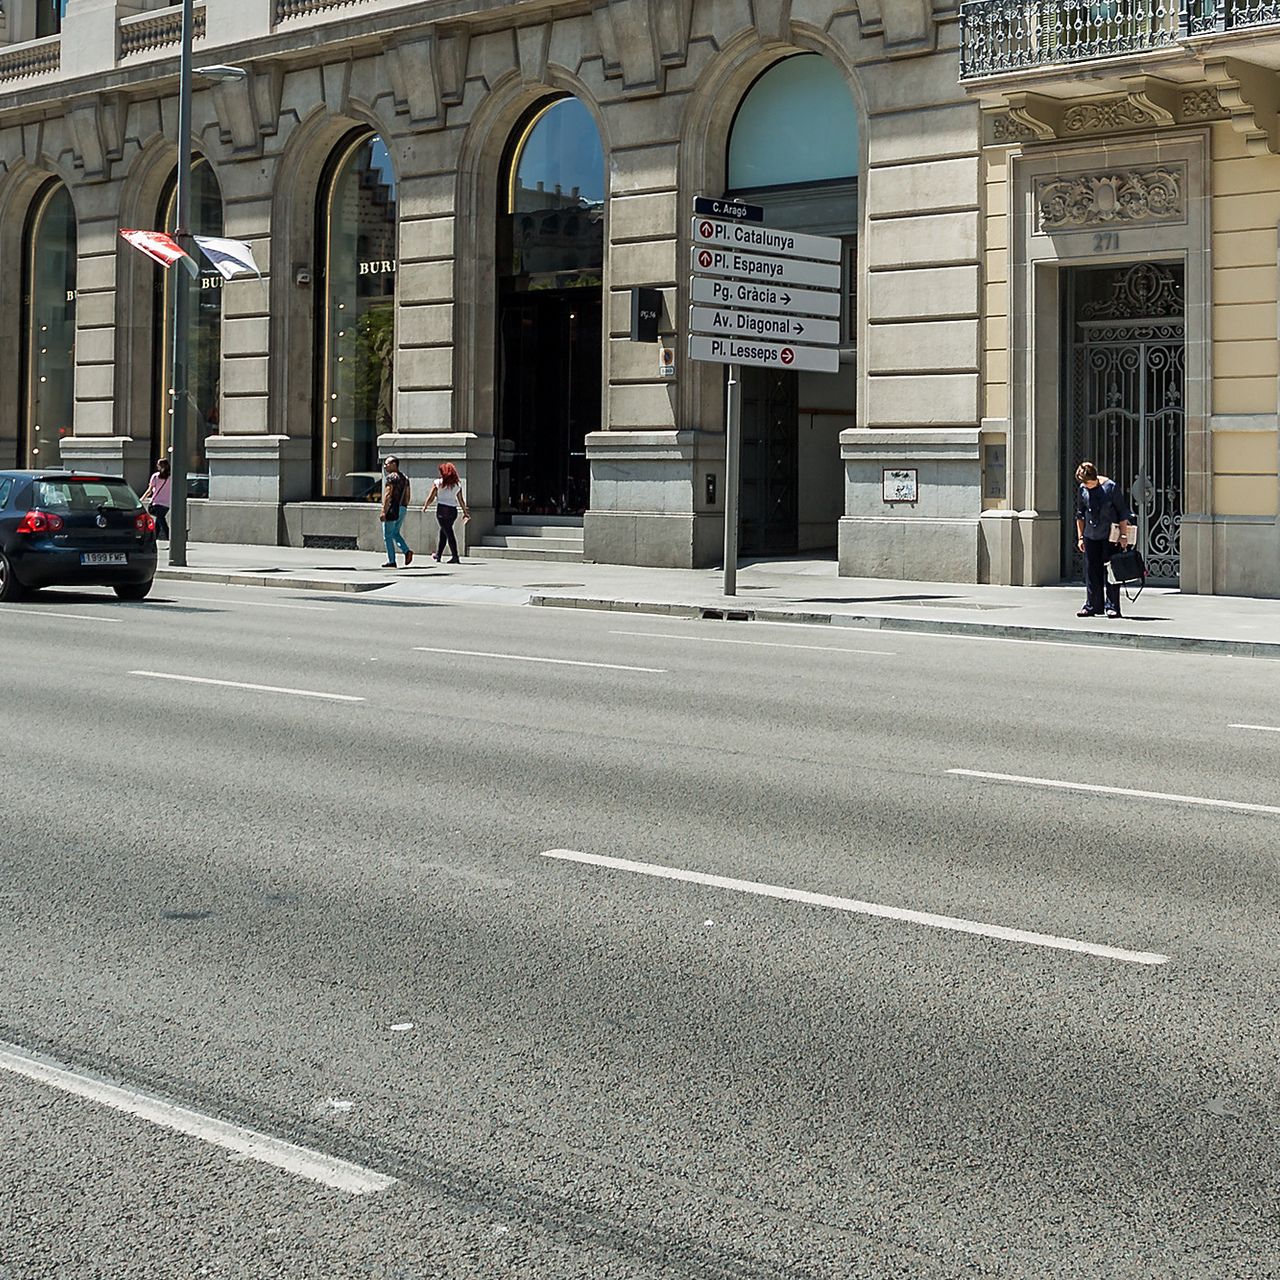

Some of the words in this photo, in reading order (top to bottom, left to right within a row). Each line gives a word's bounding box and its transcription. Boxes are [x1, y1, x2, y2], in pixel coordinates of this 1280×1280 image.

[712, 202, 721, 212] C.
[723, 204, 747, 218] Aragó
[715, 224, 730, 240] Pl.
[734, 227, 795, 251] Catalunya
[1093, 232, 1119, 252] 271
[714, 253, 729, 269] Pl.
[733, 256, 784, 277] Espanya
[713, 282, 733, 302] Pg.
[737, 285, 777, 303] Gràcia
[712, 312, 733, 328] Av.
[737, 314, 790, 334] Diagonal
[711, 340, 726, 356] Pl.
[730, 342, 778, 363] Lesseps
